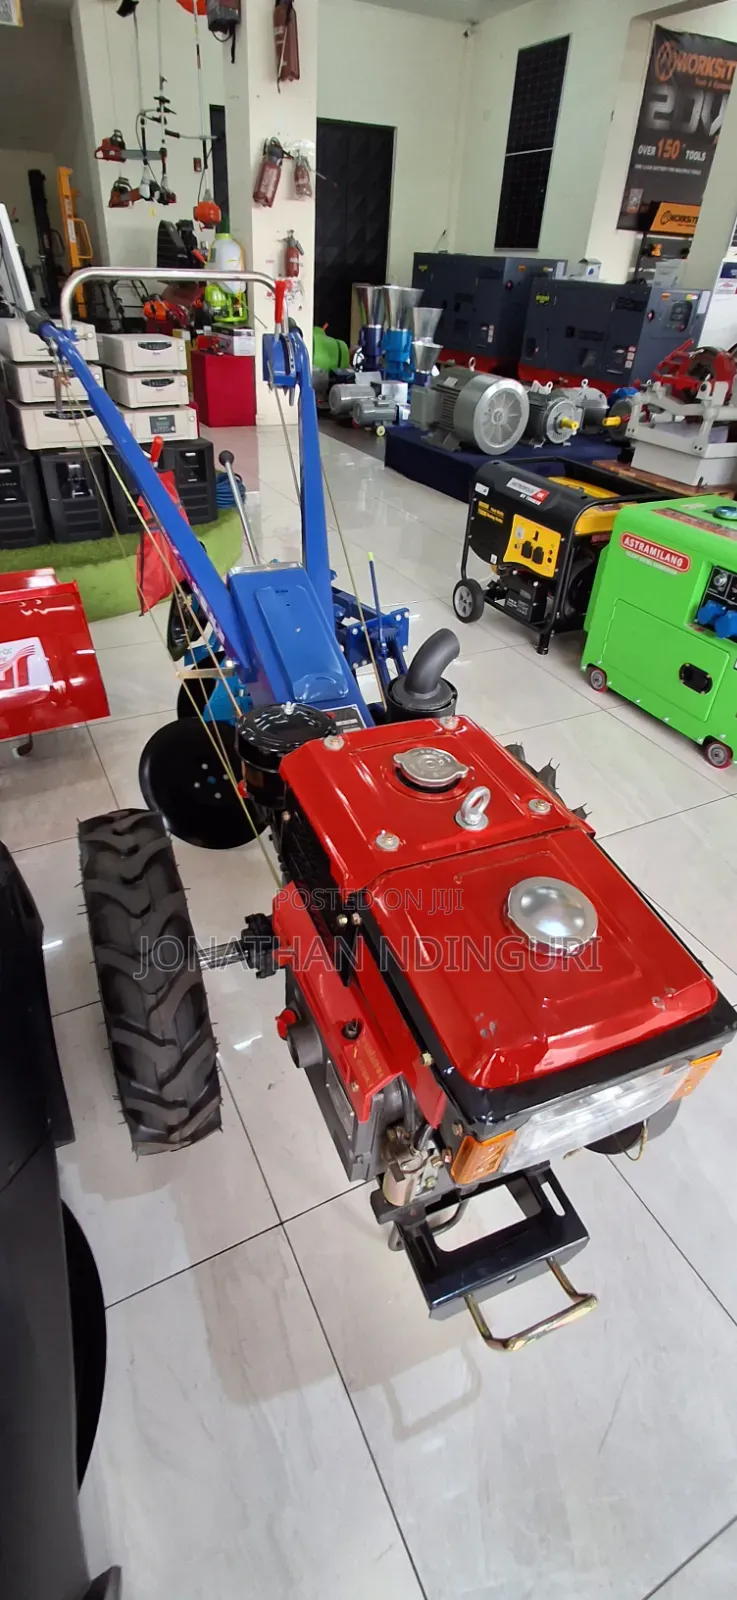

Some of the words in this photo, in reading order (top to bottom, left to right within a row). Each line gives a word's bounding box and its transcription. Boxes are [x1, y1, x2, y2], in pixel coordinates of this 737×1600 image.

[638, 144, 656, 156] OVER
[685, 150, 706, 162] TOOLS
[624, 536, 683, 567] ASTRAMILANO
